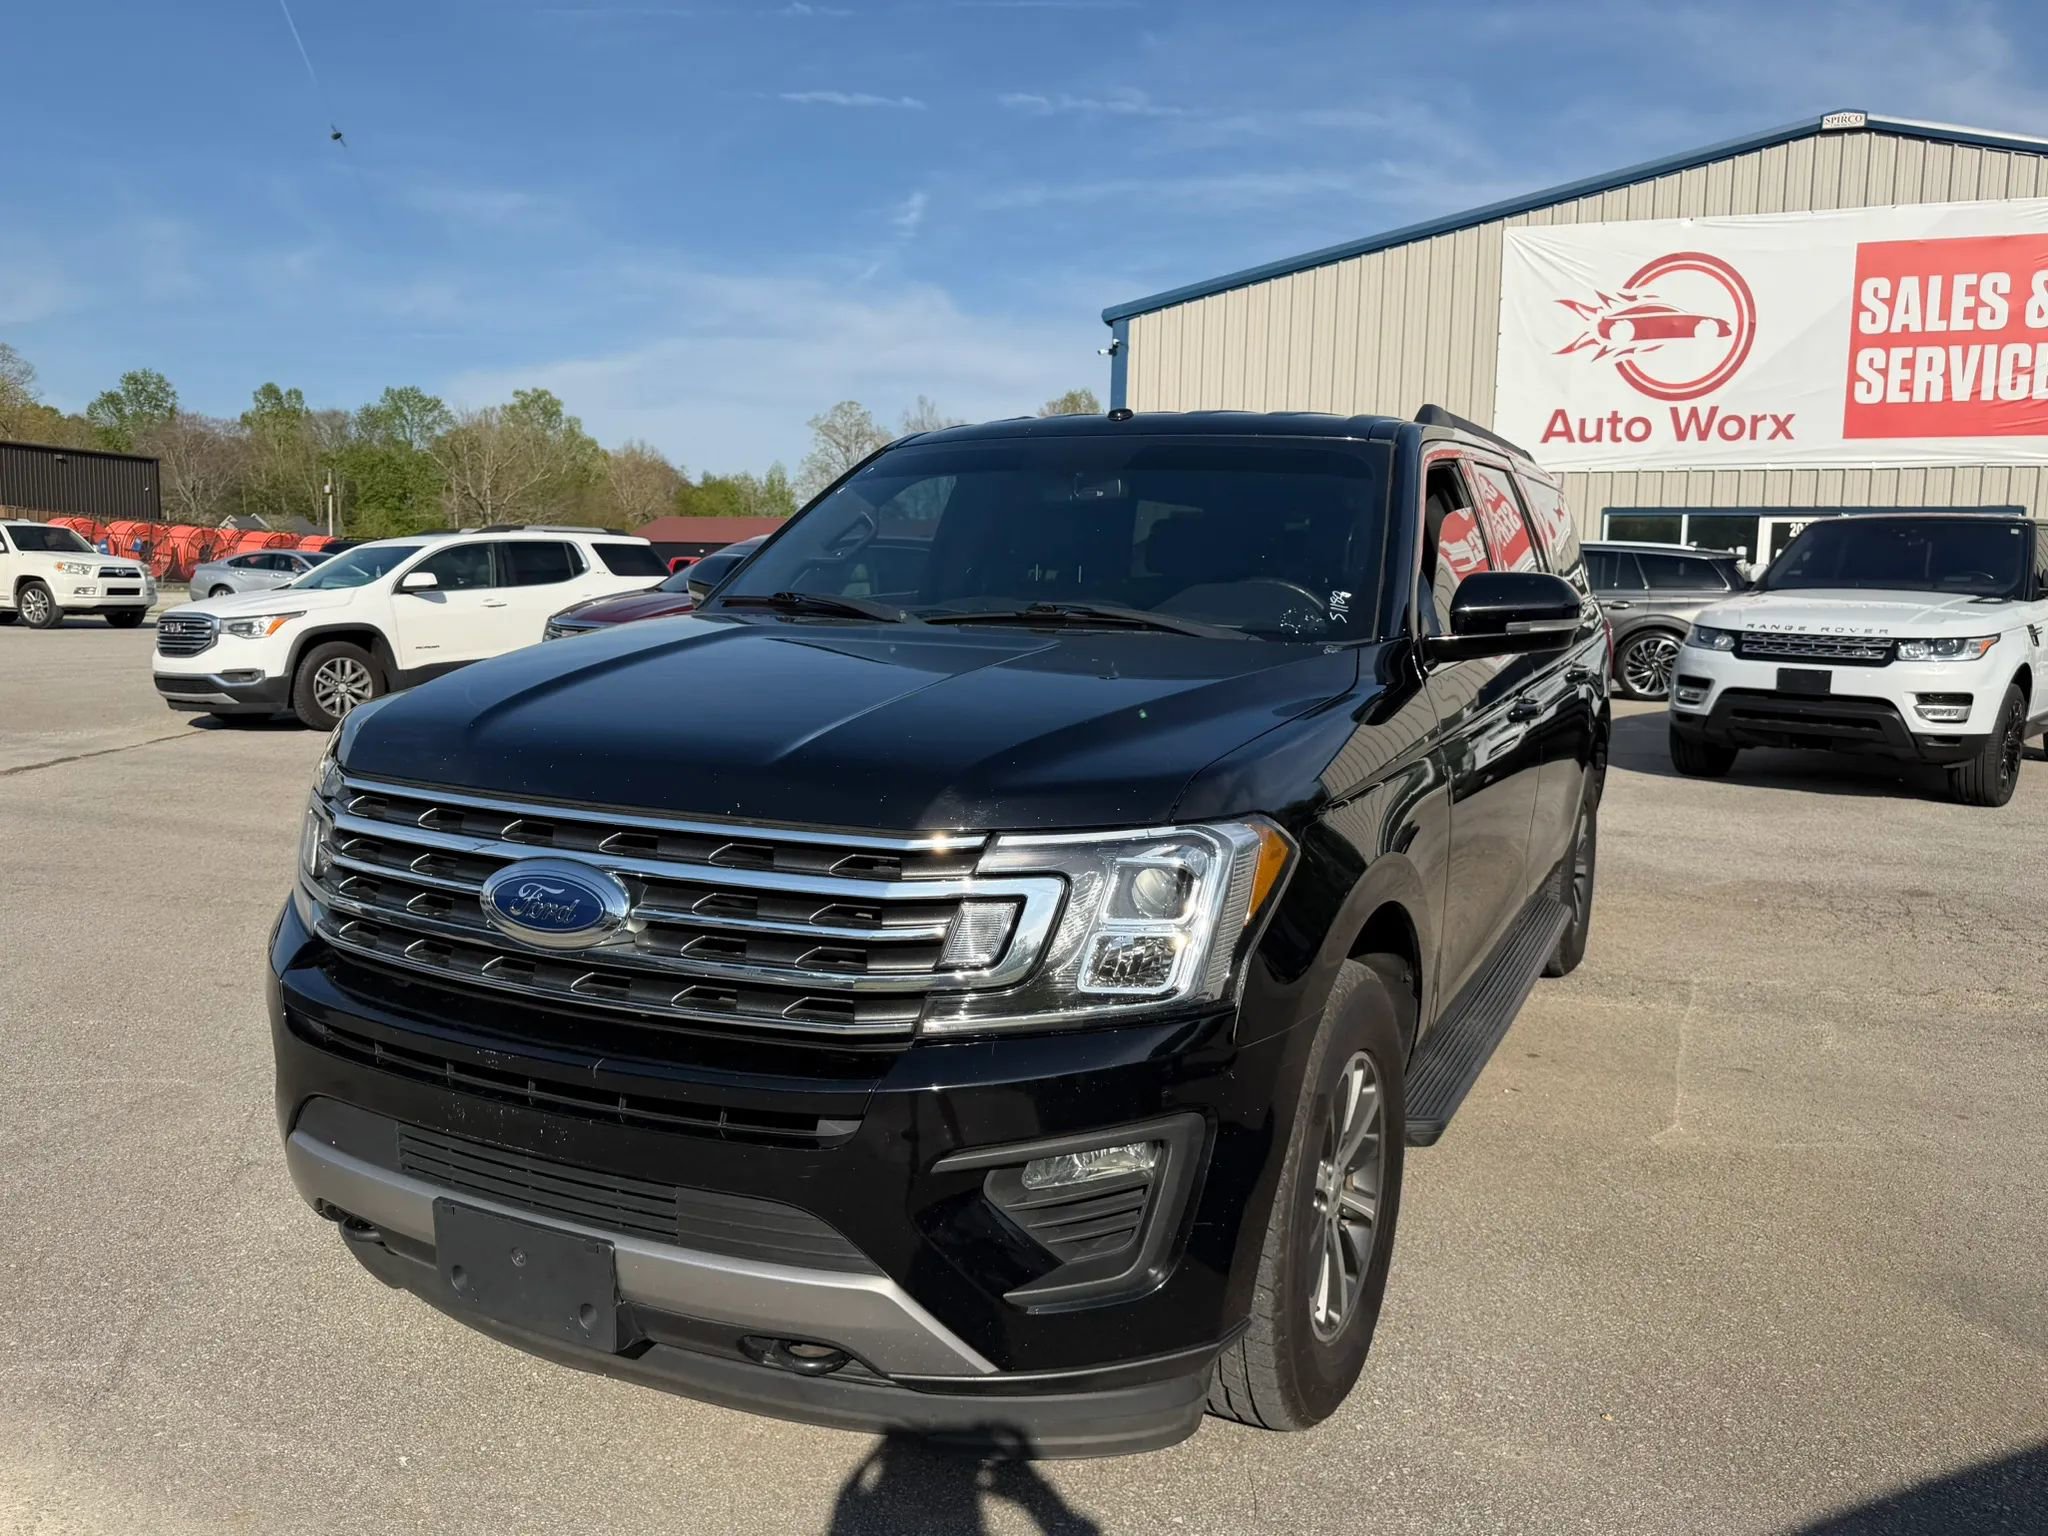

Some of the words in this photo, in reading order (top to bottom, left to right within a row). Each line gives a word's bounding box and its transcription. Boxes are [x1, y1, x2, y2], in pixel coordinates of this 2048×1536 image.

[1824, 115, 1863, 125] SPIRCO
[1858, 272, 2011, 335] SALES
[2025, 269, 2048, 329] &
[1540, 409, 1652, 443] Auto
[1669, 405, 1795, 442] Worx
[1789, 522, 1809, 538] 20
[1745, 623, 1807, 631] RANGE
[1820, 627, 1889, 635] ROVER
[509, 882, 581, 924] Ford
